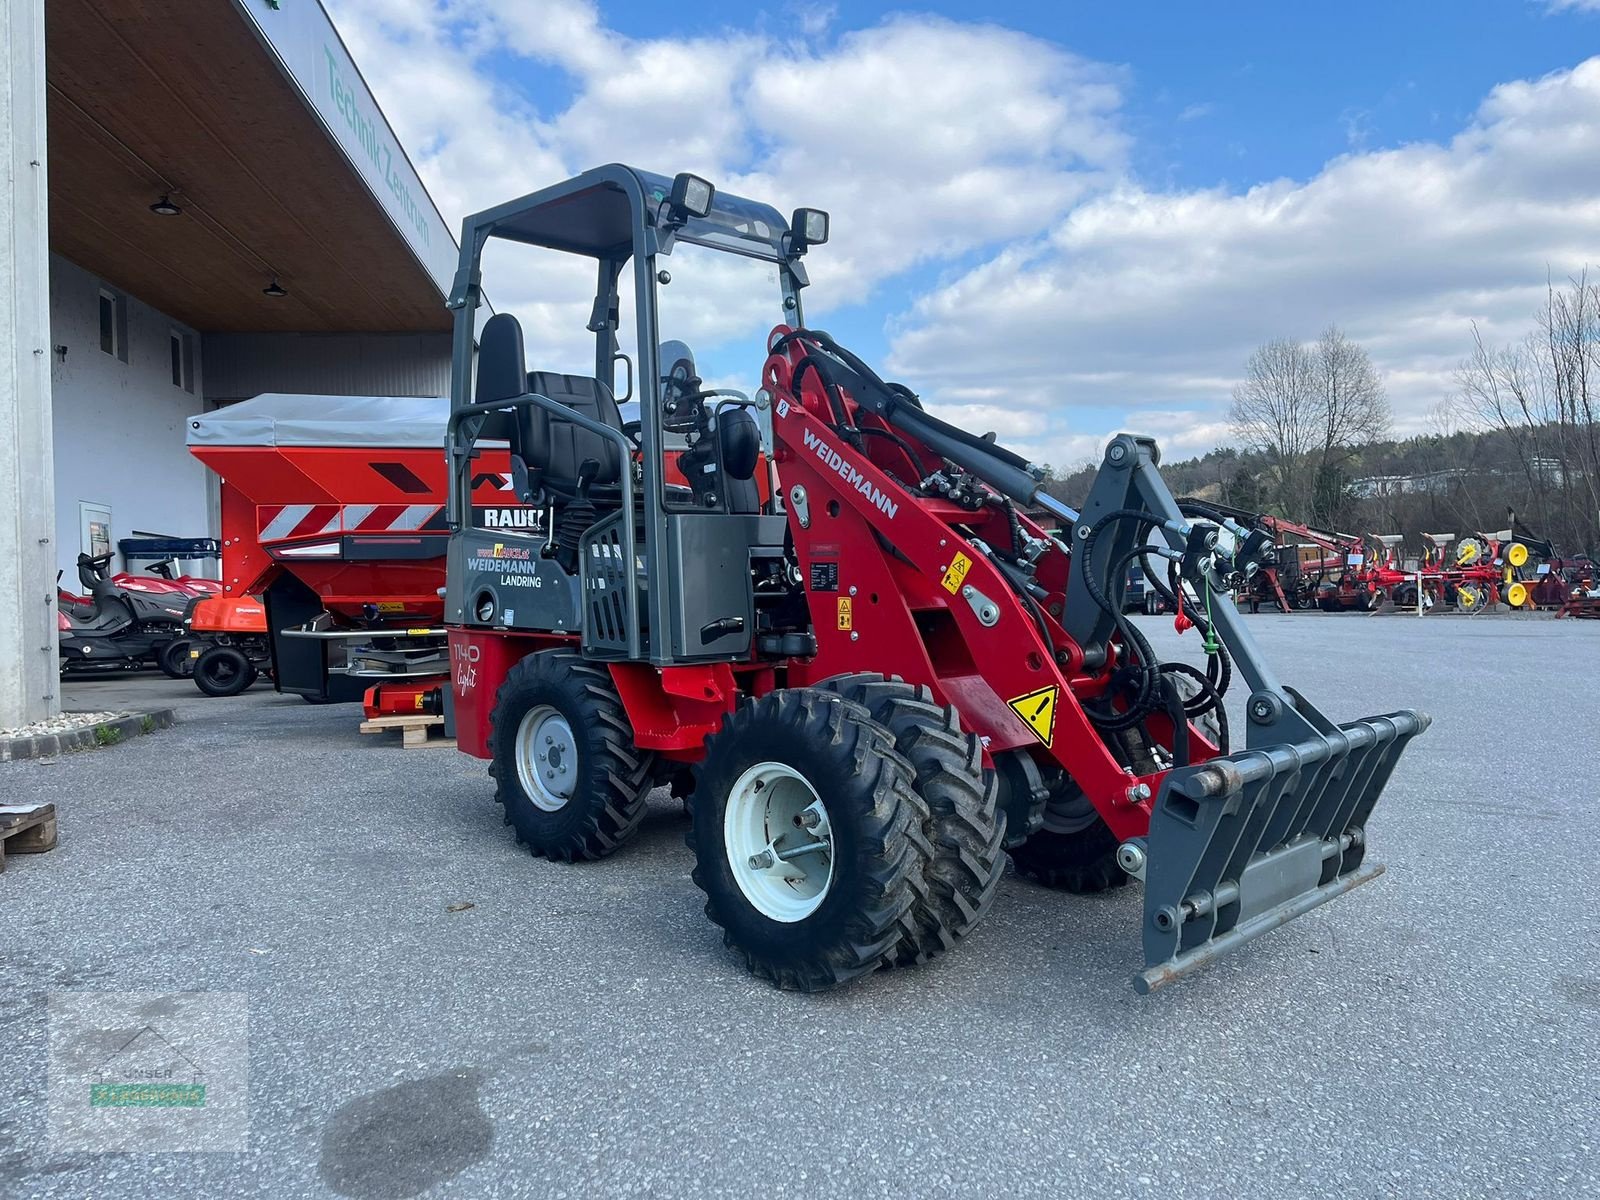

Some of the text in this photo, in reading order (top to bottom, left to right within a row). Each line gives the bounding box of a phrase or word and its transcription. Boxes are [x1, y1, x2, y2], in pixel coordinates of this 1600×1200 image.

[324, 43, 430, 248] Technik Zentrum
[803, 427, 899, 520] WEIDEMANN
[468, 558, 536, 574] WEIDEMANN
[501, 574, 542, 588] LANDRING
[454, 644, 480, 663] 1140
[457, 663, 477, 697] light
